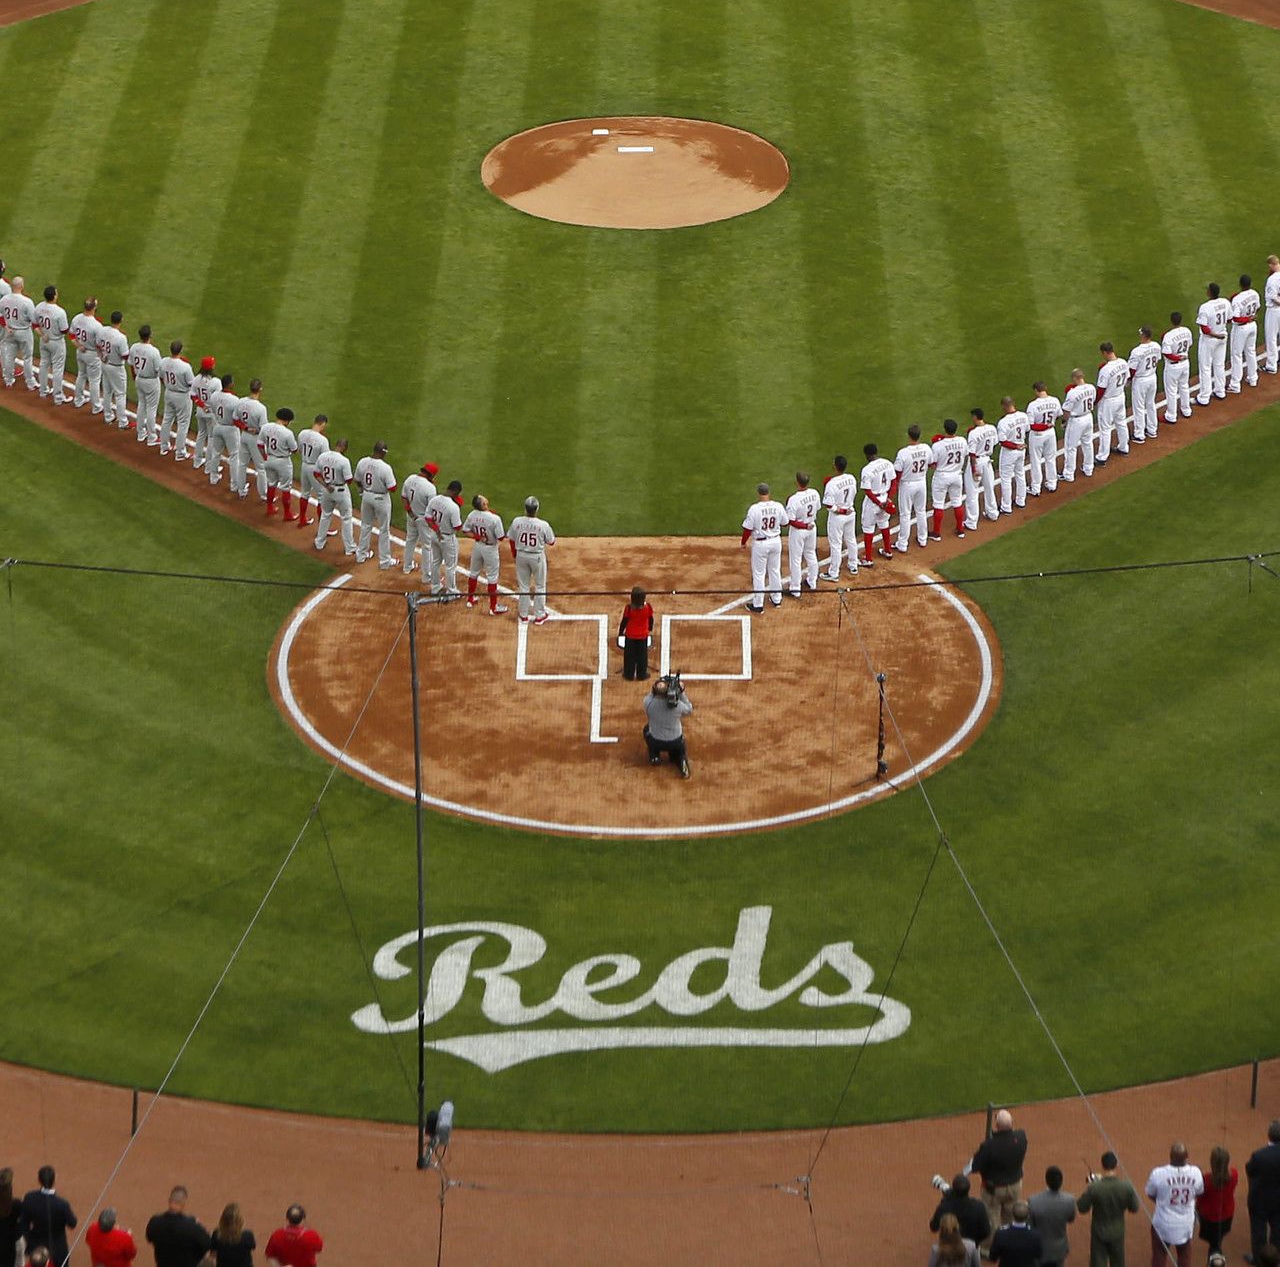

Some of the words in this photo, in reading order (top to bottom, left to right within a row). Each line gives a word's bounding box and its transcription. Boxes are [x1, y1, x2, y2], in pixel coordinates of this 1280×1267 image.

[4, 306, 19, 321] 34
[1215, 312, 1227, 326] 31
[1177, 340, 1189, 354] 29
[133, 356, 147, 371] 27
[1145, 356, 1157, 371] 28
[165, 371, 177, 385] 18
[1115, 373, 1127, 388] 27
[197, 387, 208, 402] 15
[217, 405, 224, 419] 4
[1082, 399, 1093, 412] 16
[242, 411, 249, 423] 2
[1042, 411, 1053, 424] 15
[1015, 426, 1022, 440] 3
[266, 435, 277, 451] 13
[302, 442, 314, 458] 17
[984, 438, 991, 451] 6
[946, 450, 962, 466] 23
[323, 466, 336, 481] 21
[912, 459, 926, 474] 32
[365, 472, 373, 486] 6
[880, 472, 888, 485] 4
[409, 488, 415, 502] 7
[843, 488, 850, 503] 7
[806, 505, 814, 518] 2
[761, 516, 776, 531] 38
[519, 532, 538, 548] 45
[350, 905, 912, 1075] Reds
[1169, 1188, 1190, 1206] 23
